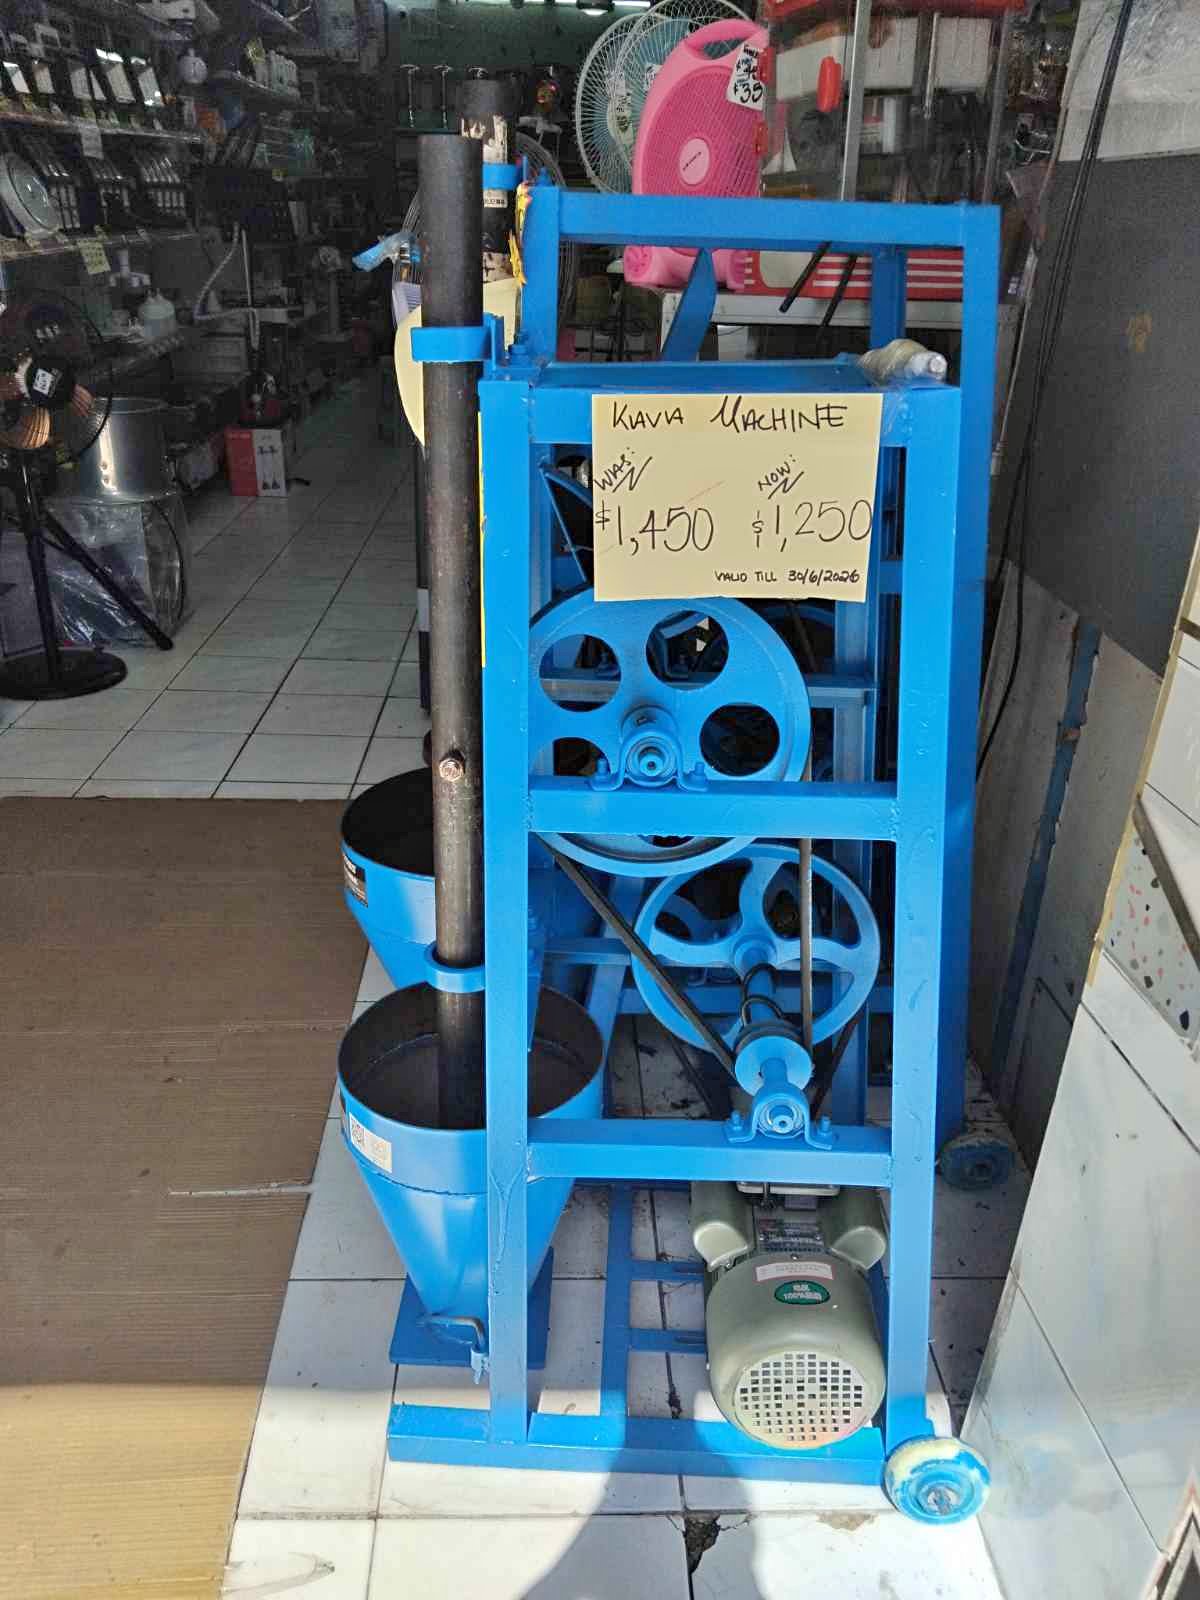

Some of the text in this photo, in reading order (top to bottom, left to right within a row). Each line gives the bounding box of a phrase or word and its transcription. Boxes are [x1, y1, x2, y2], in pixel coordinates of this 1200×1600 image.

[613, 395, 848, 433] KAVA MACHINE
[595, 499, 714, 556] $1,450
[751, 499, 873, 553] $1,250
[714, 568, 860, 586] VALID TILL 30/6/2026
